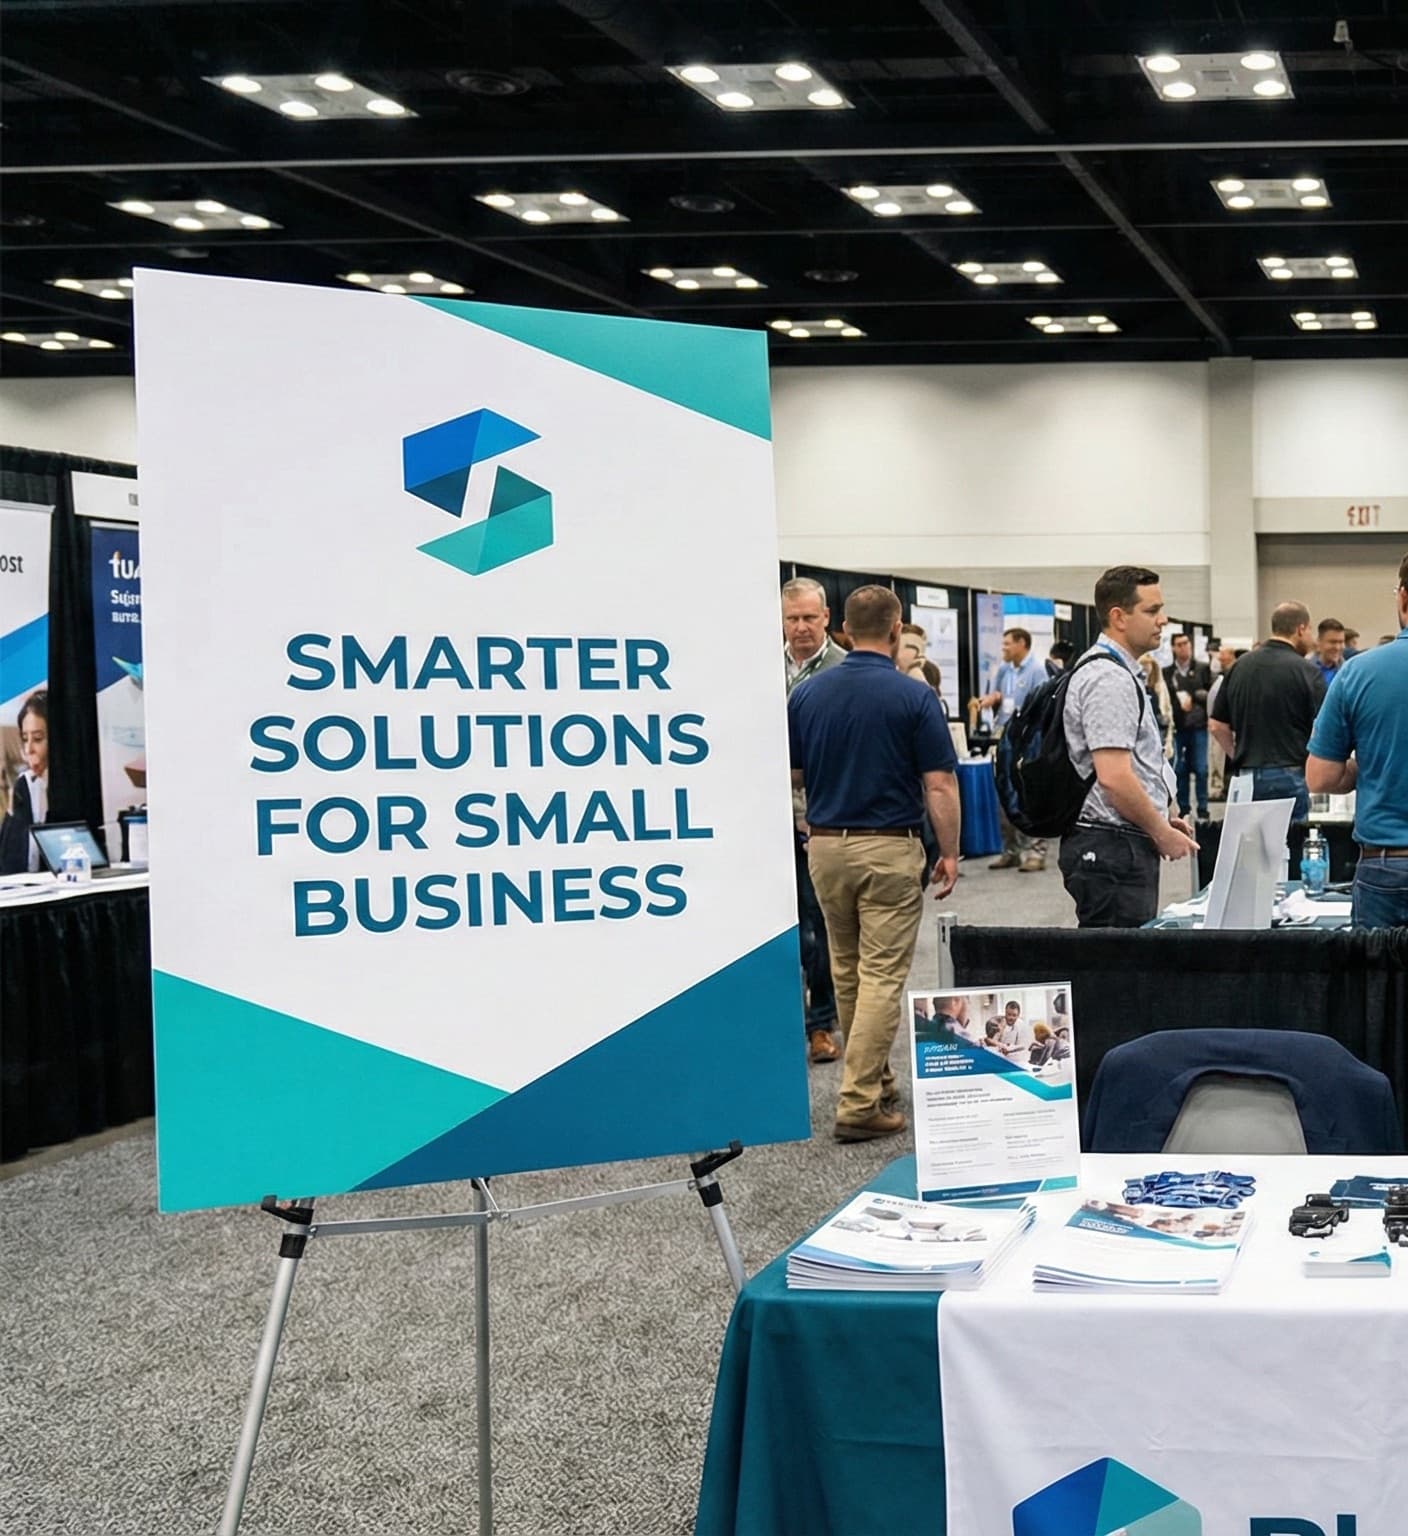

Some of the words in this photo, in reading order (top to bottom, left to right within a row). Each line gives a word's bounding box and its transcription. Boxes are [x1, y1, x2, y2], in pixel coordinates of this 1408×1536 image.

[286, 633, 672, 691] SMARTER
[249, 713, 710, 773] SOLUTIONS
[256, 795, 429, 857] FOR
[454, 787, 714, 849] SMALL
[293, 863, 688, 937] BUSINESS
